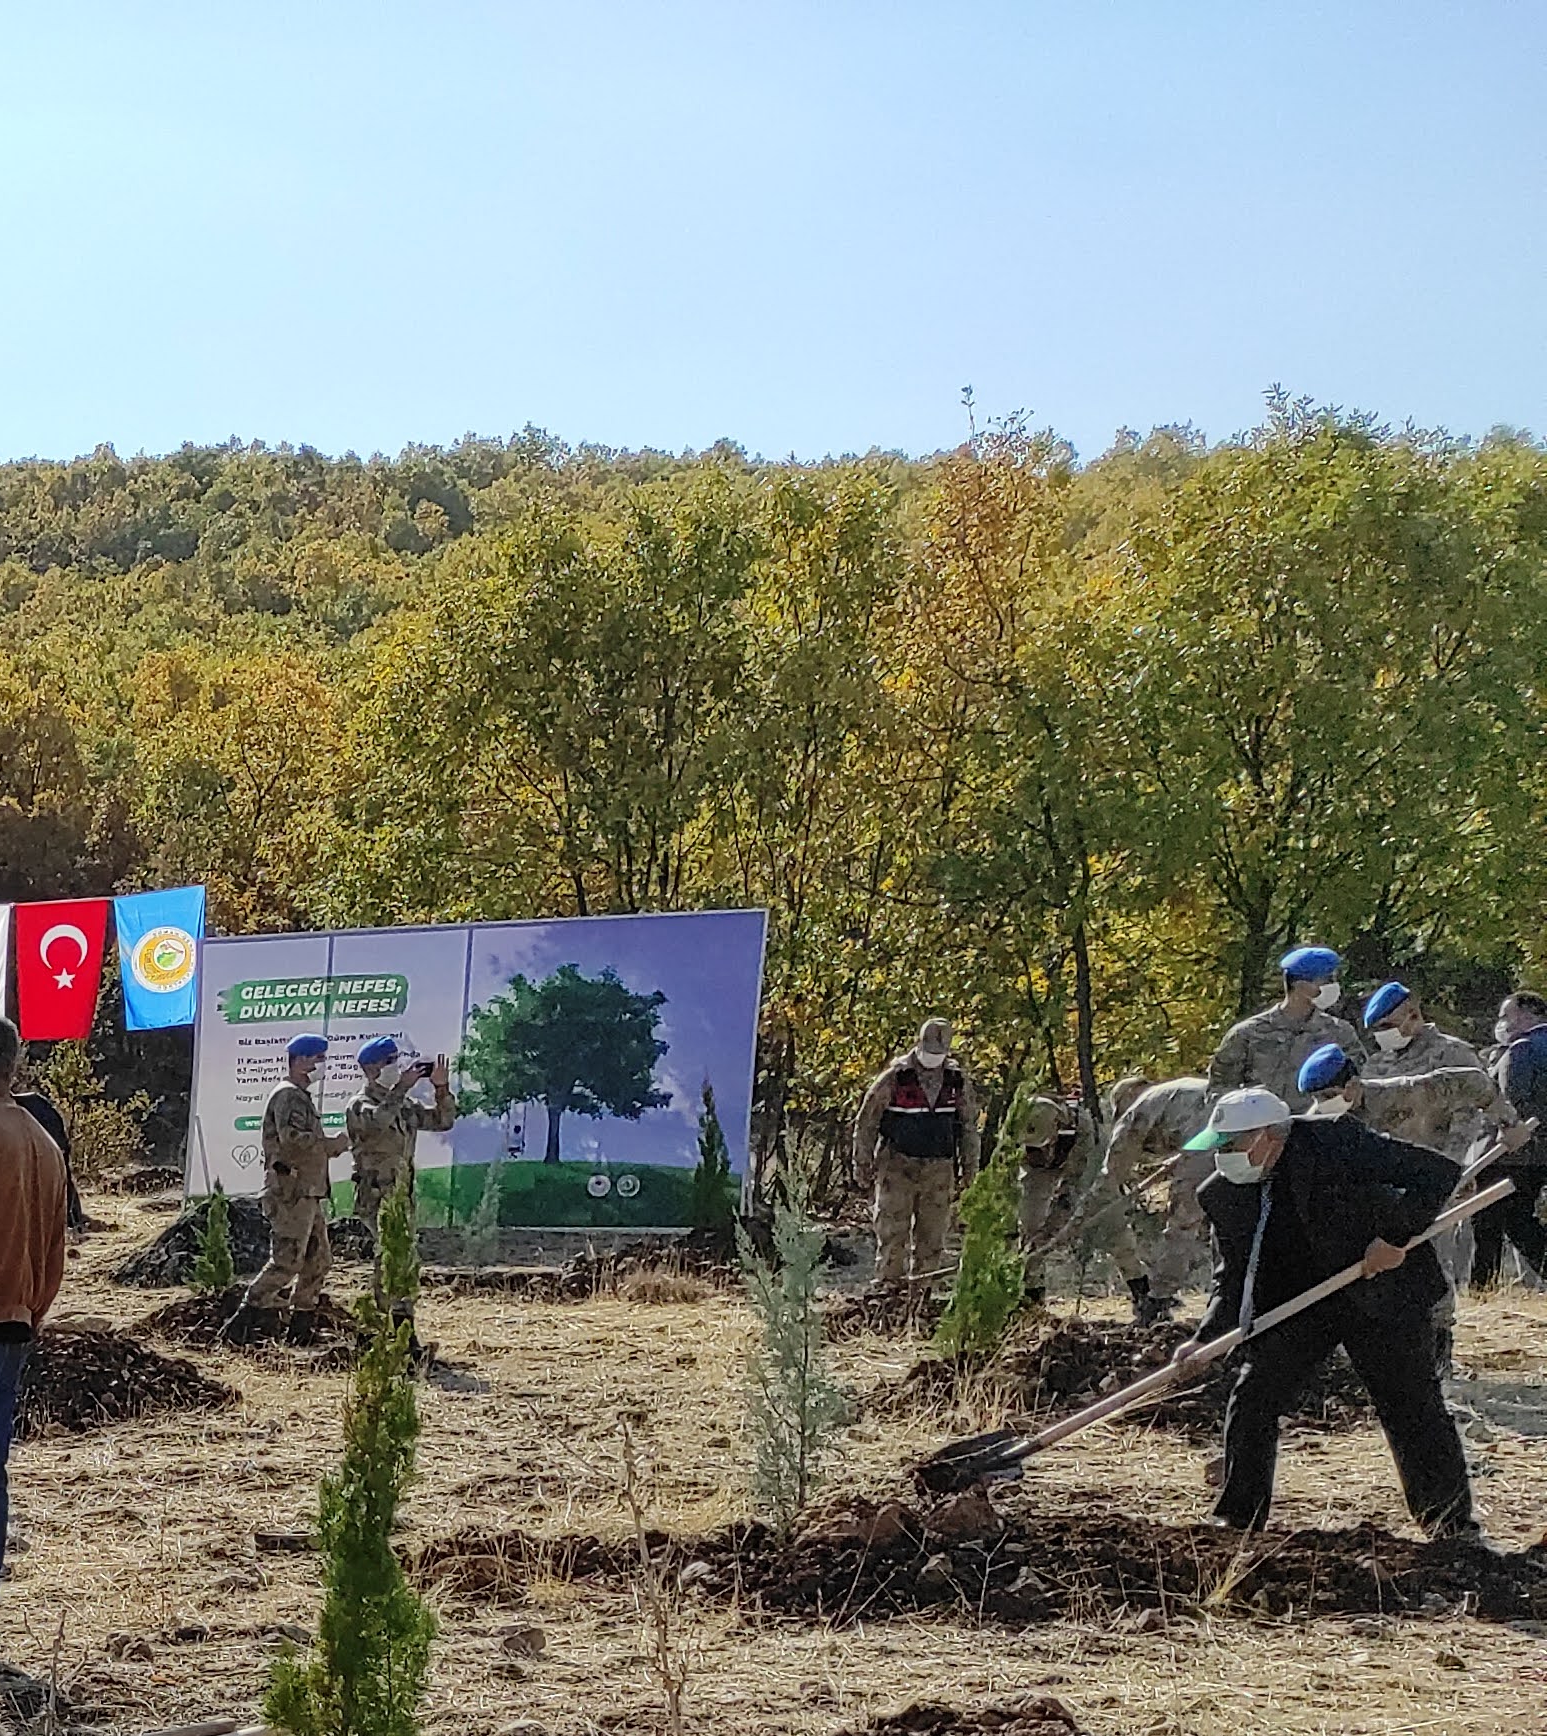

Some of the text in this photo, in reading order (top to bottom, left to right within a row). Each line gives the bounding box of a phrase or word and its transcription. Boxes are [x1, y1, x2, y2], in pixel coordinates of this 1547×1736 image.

[240, 978, 403, 1000] GELECEĞE NEFES,
[239, 998, 398, 1019] DÜNYAYA NEFES!
